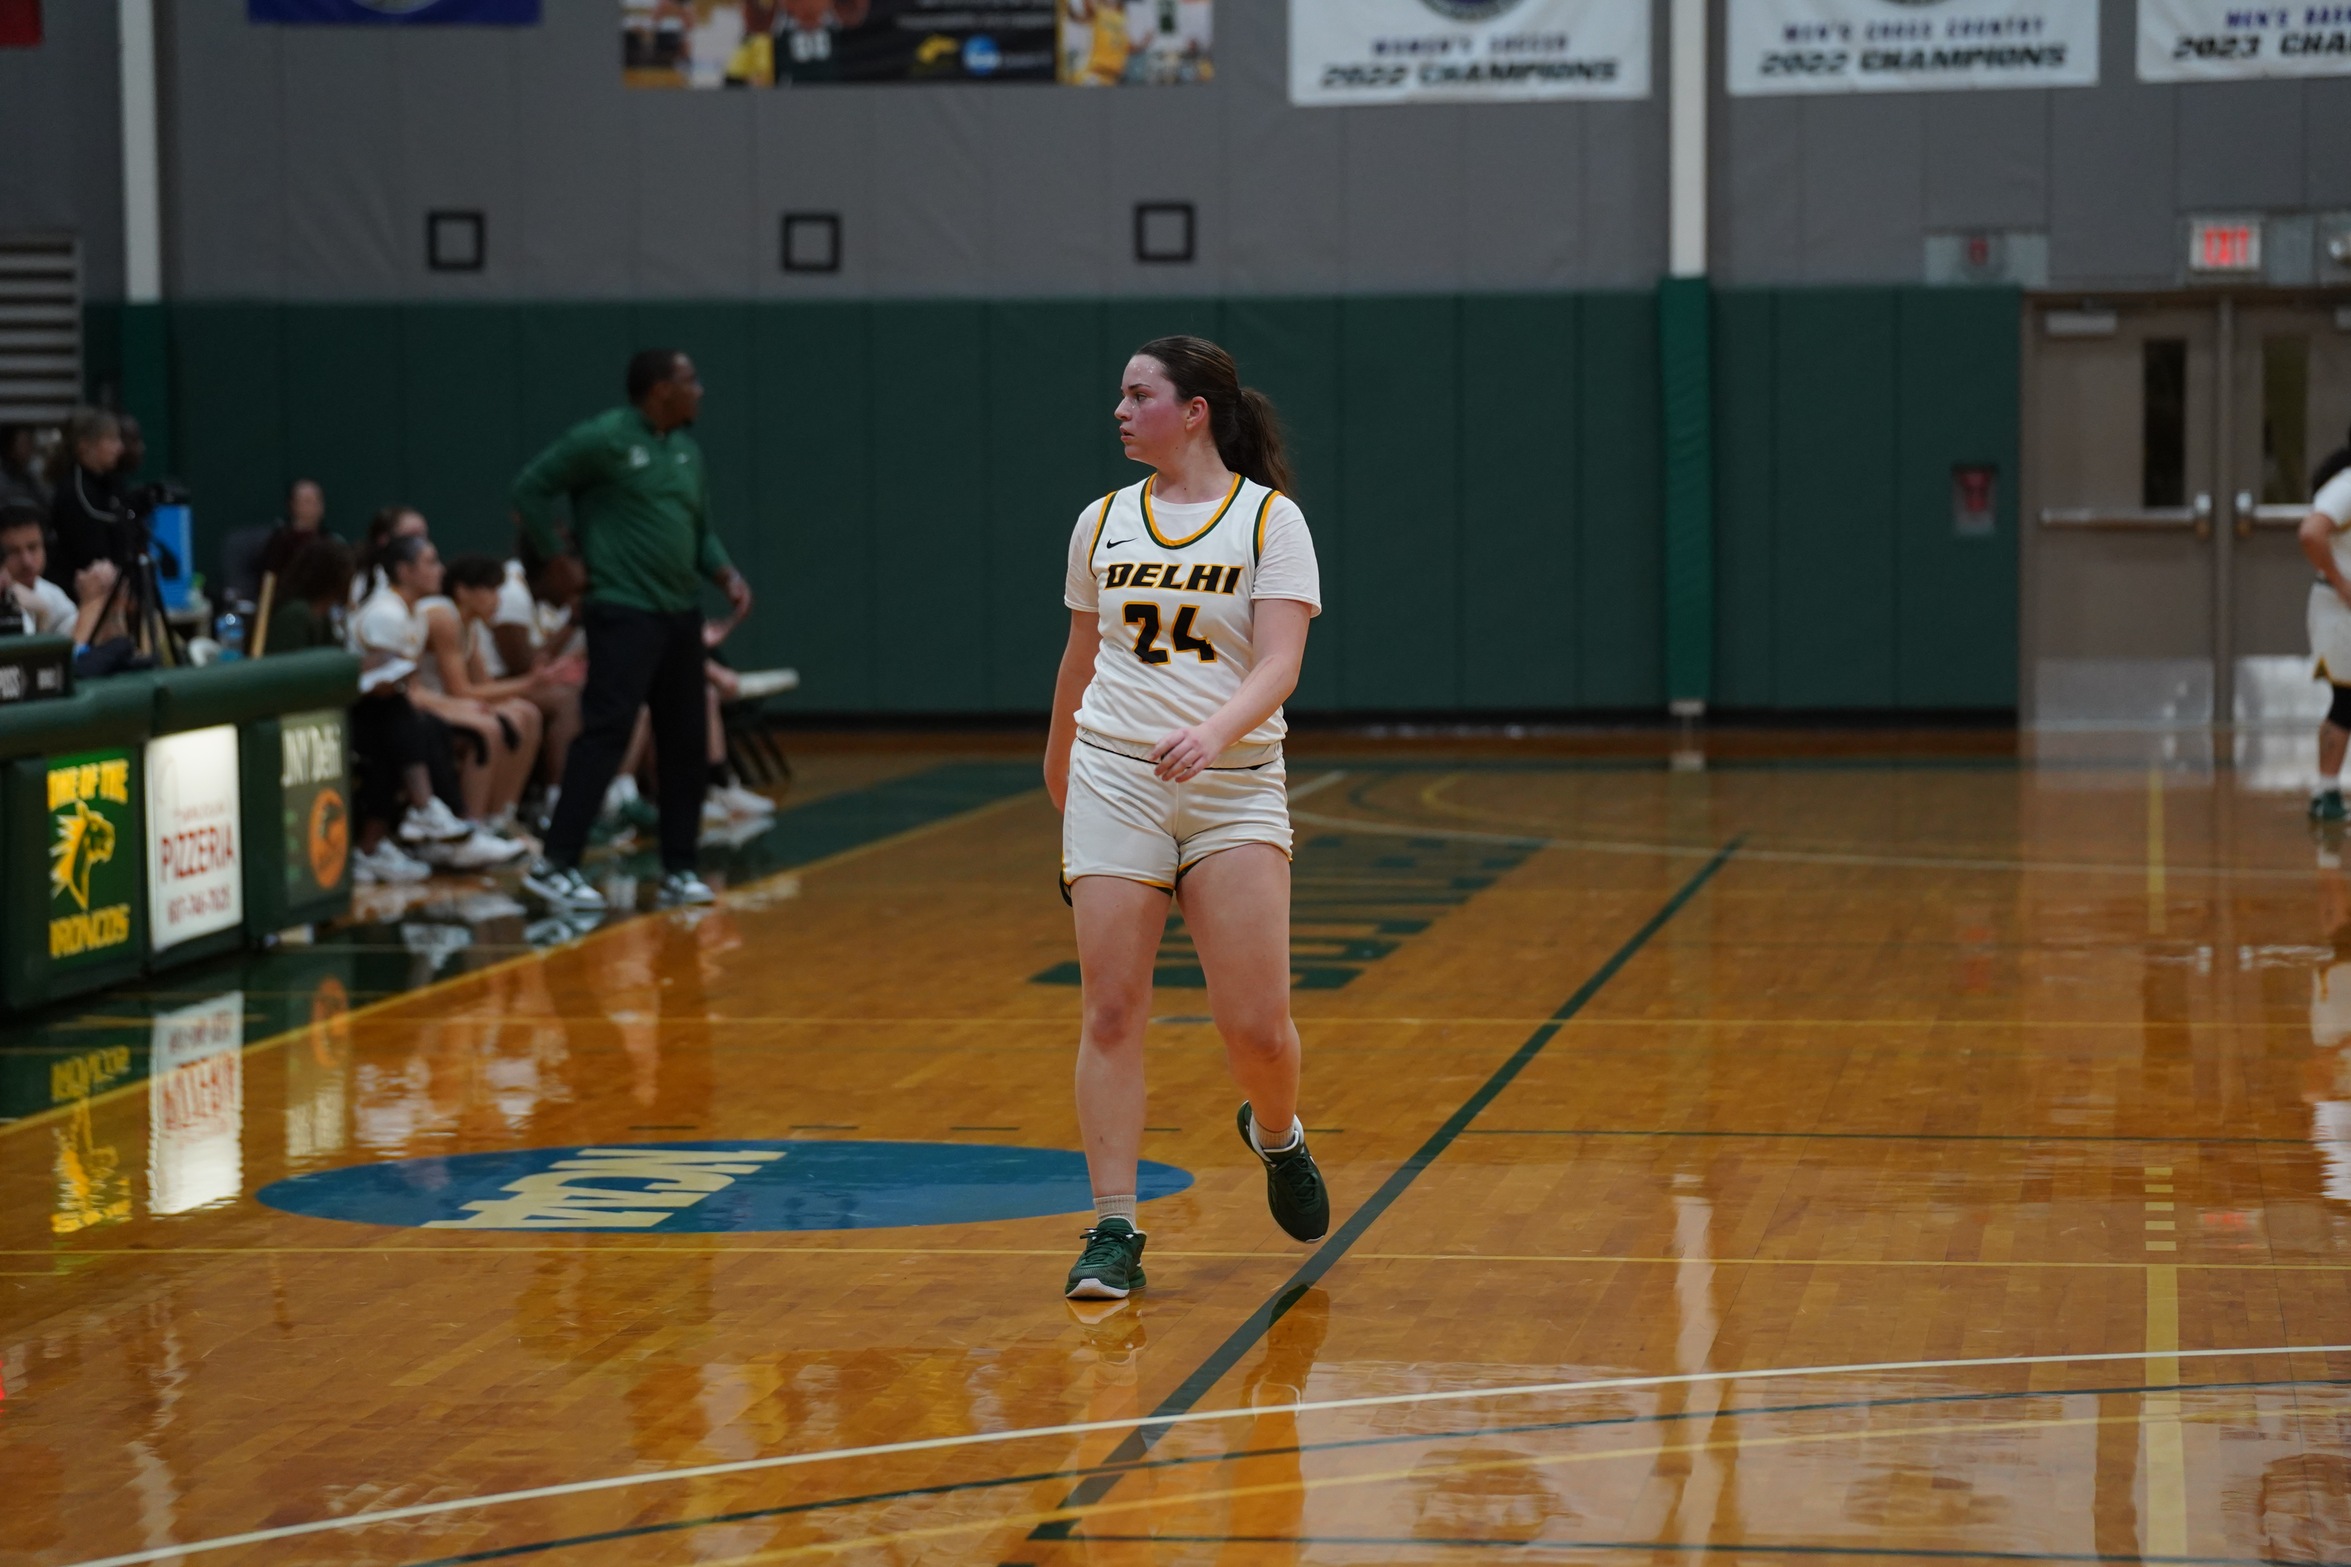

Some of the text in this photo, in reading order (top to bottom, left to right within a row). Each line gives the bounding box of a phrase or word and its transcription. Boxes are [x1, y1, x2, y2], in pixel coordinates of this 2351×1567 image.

[1760, 43, 2067, 76] 2022 CHAMPIONS
[2173, 31, 2351, 60] 2023 CHA
[1321, 58, 1619, 88] 2022 CHAMPIONS
[2204, 225, 2249, 266] EXIT
[1104, 562, 1245, 596] DELHI
[1122, 601, 1218, 667] 24
[161, 823, 234, 884] PIZZERIA
[420, 1148, 788, 1229] NCAA
